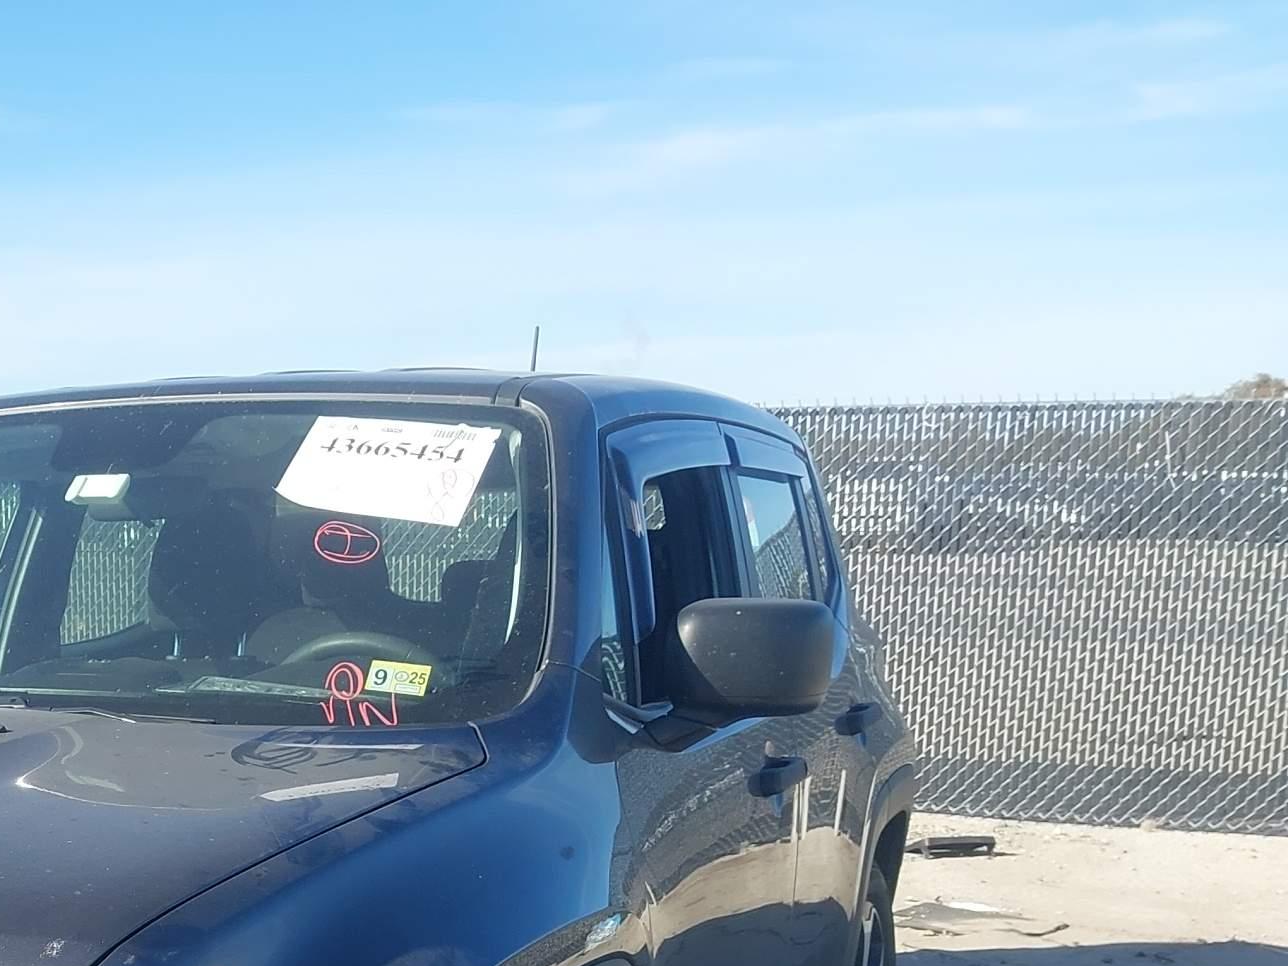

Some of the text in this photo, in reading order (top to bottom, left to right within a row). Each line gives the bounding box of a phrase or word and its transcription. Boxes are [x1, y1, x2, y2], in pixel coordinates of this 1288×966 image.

[320, 437, 465, 463] 43665454
[373, 669, 388, 686] 9
[408, 671, 427, 686] 25
[319, 693, 398, 727] VIN
